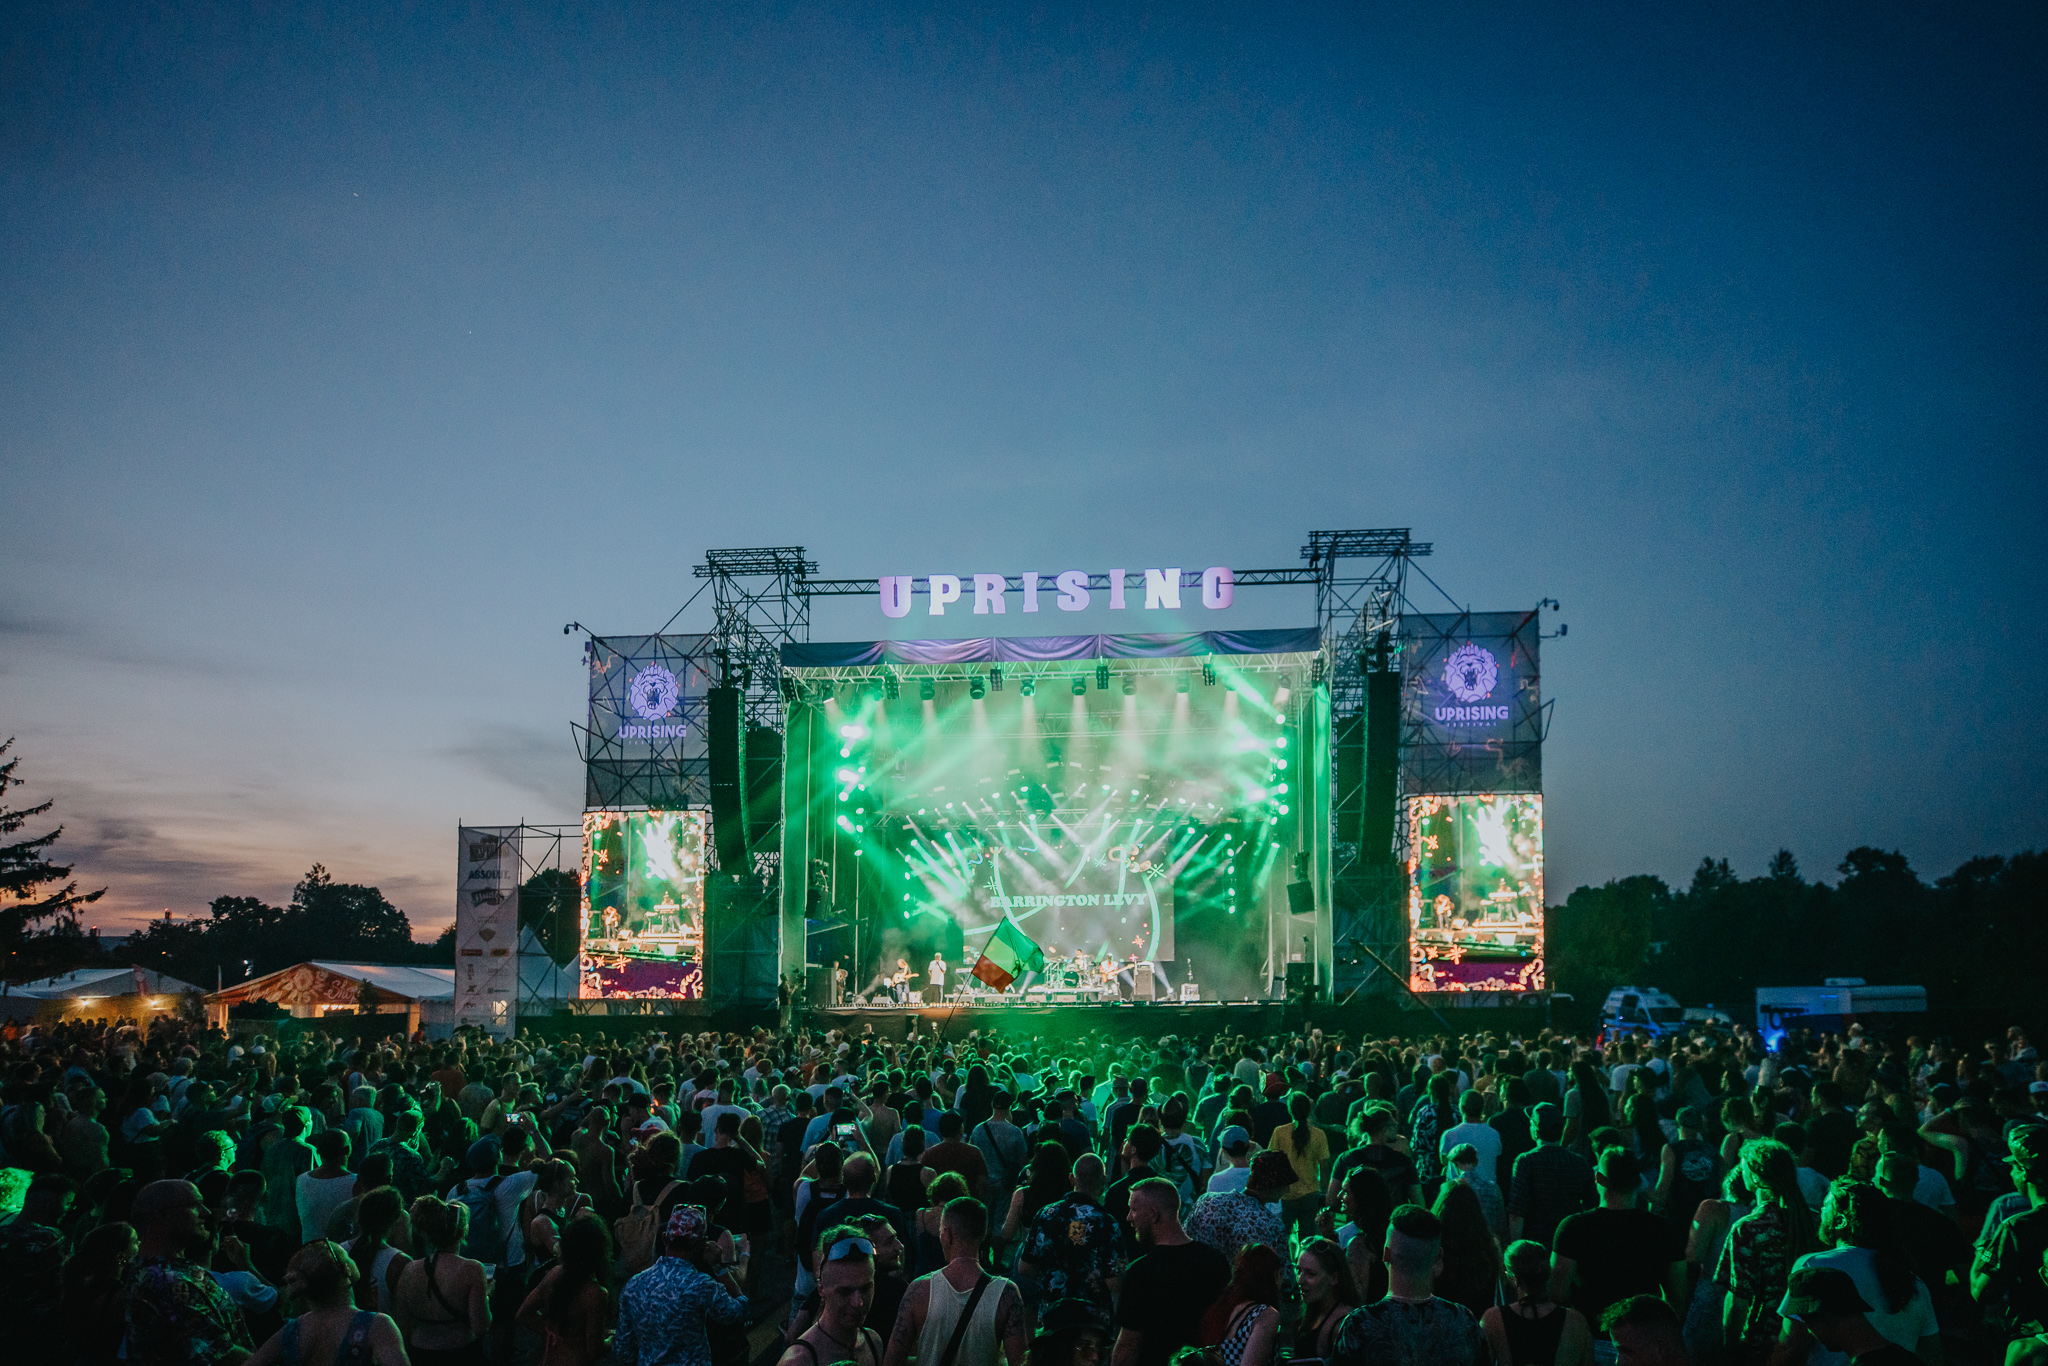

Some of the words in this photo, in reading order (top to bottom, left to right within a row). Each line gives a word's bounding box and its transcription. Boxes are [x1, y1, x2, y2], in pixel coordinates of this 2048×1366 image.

[878, 566, 1234, 618] UPRISING
[1435, 705, 1509, 721] UPRISING
[618, 724, 687, 739] UPRISING
[990, 894, 1100, 908] BARRINGTON
[1103, 893, 1148, 906] LEVY
